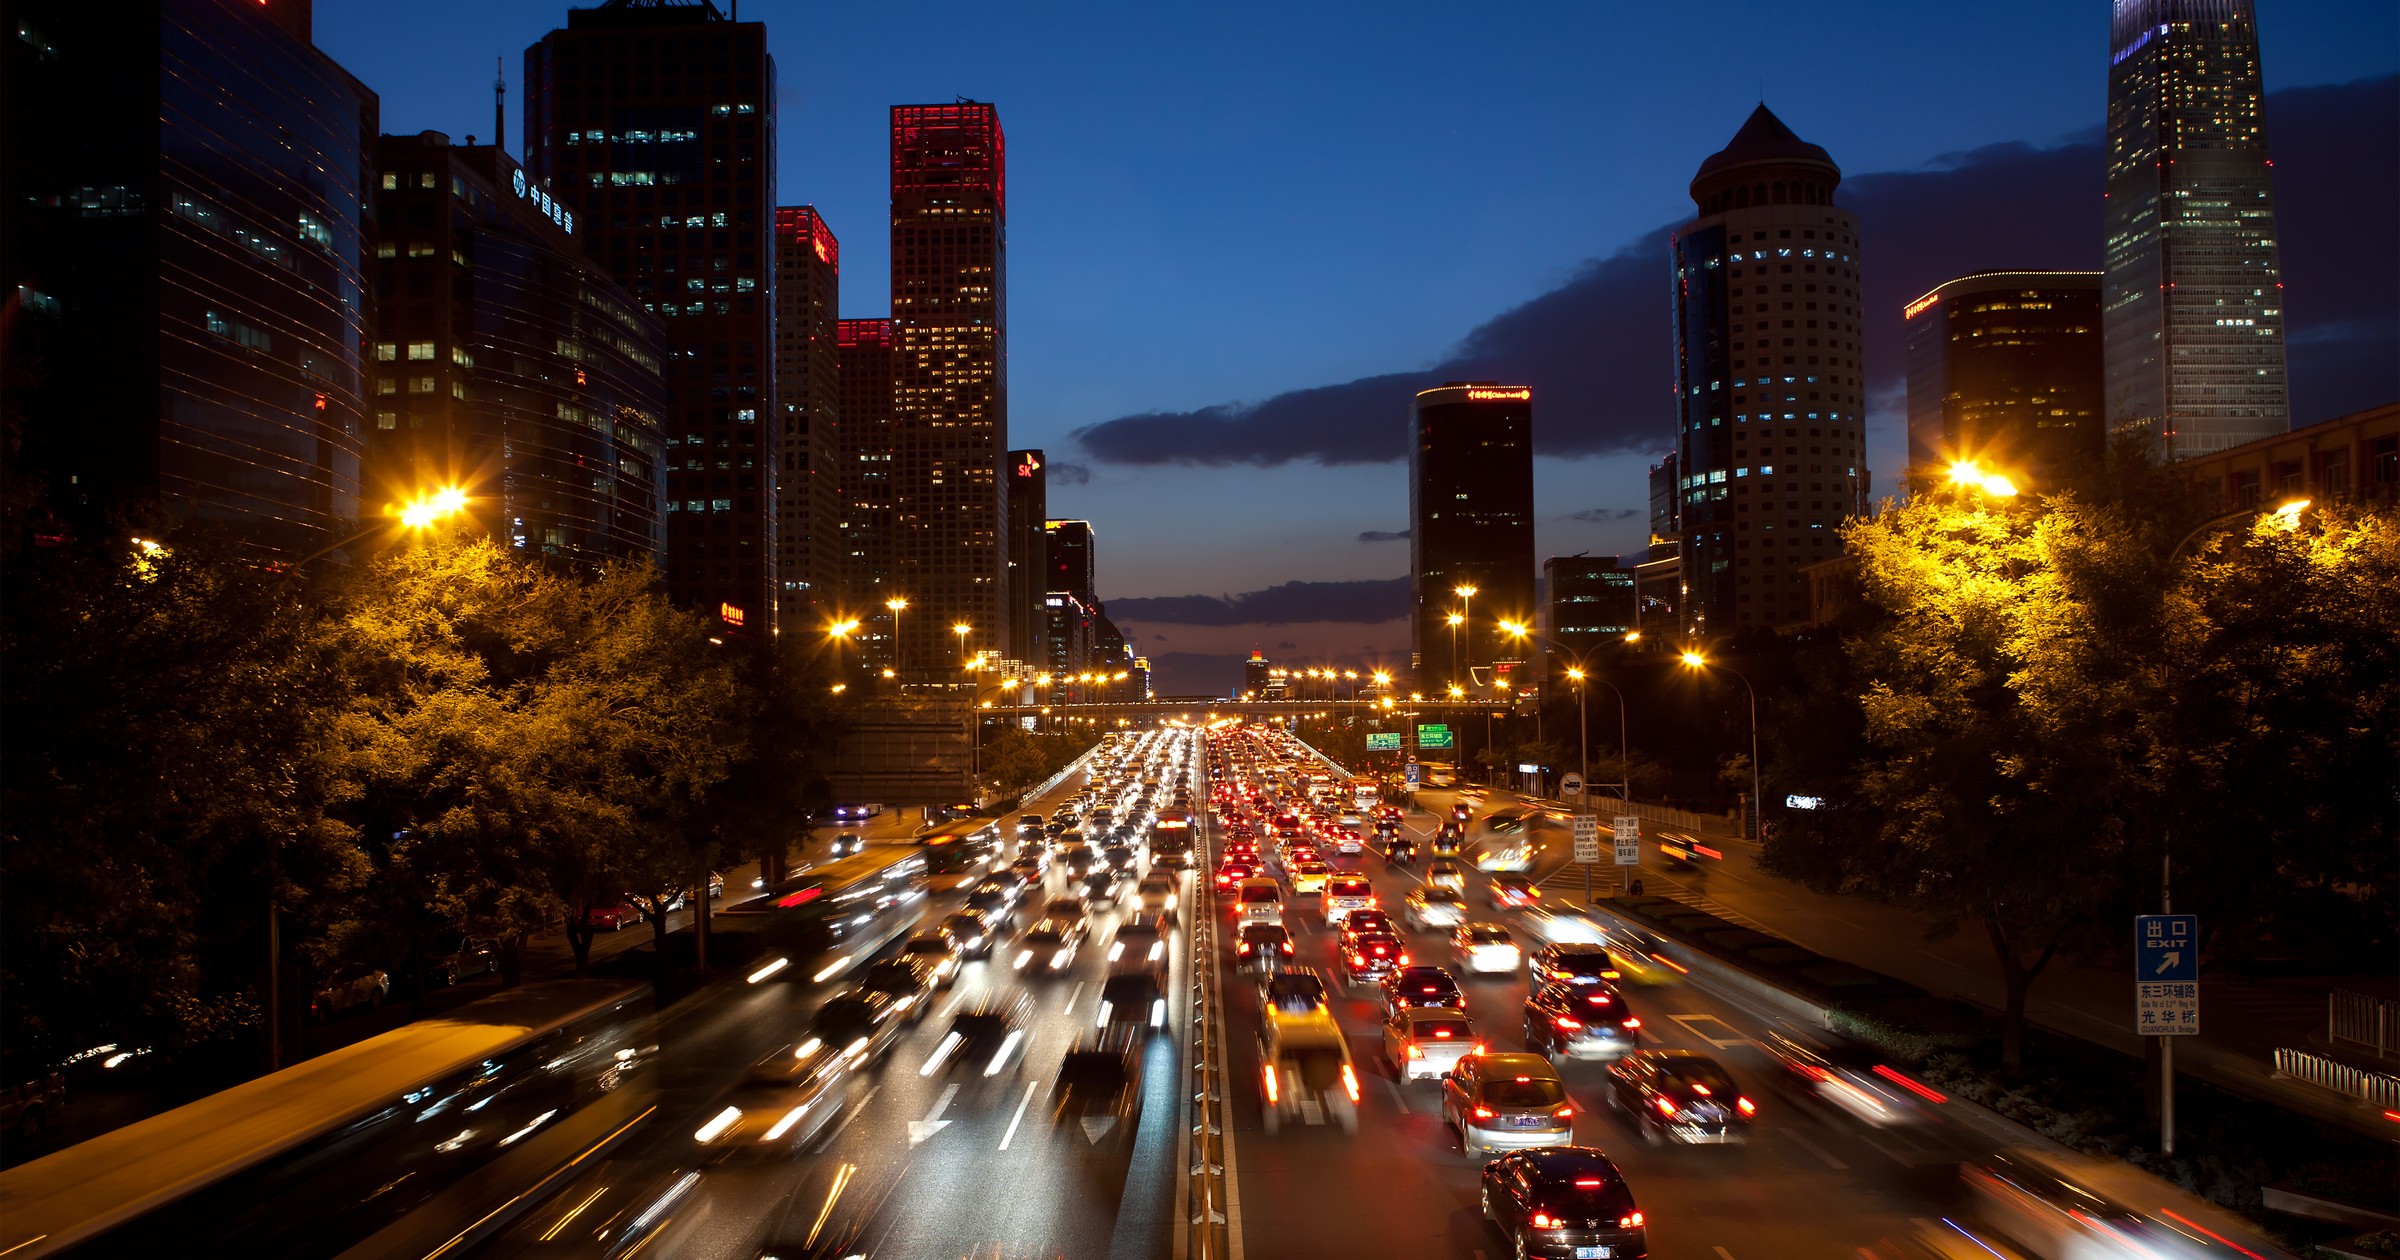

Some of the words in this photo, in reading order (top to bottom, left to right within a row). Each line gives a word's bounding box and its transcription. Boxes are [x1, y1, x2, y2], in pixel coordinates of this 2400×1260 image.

[530, 185, 573, 235] 中国惠普
[1018, 464, 1032, 477] SK
[2147, 920, 2187, 938] 出口
[2146, 939, 2188, 948] EXIT
[2141, 984, 2195, 999] 东三环辅路
[2141, 1010, 2196, 1024] 光华桥
